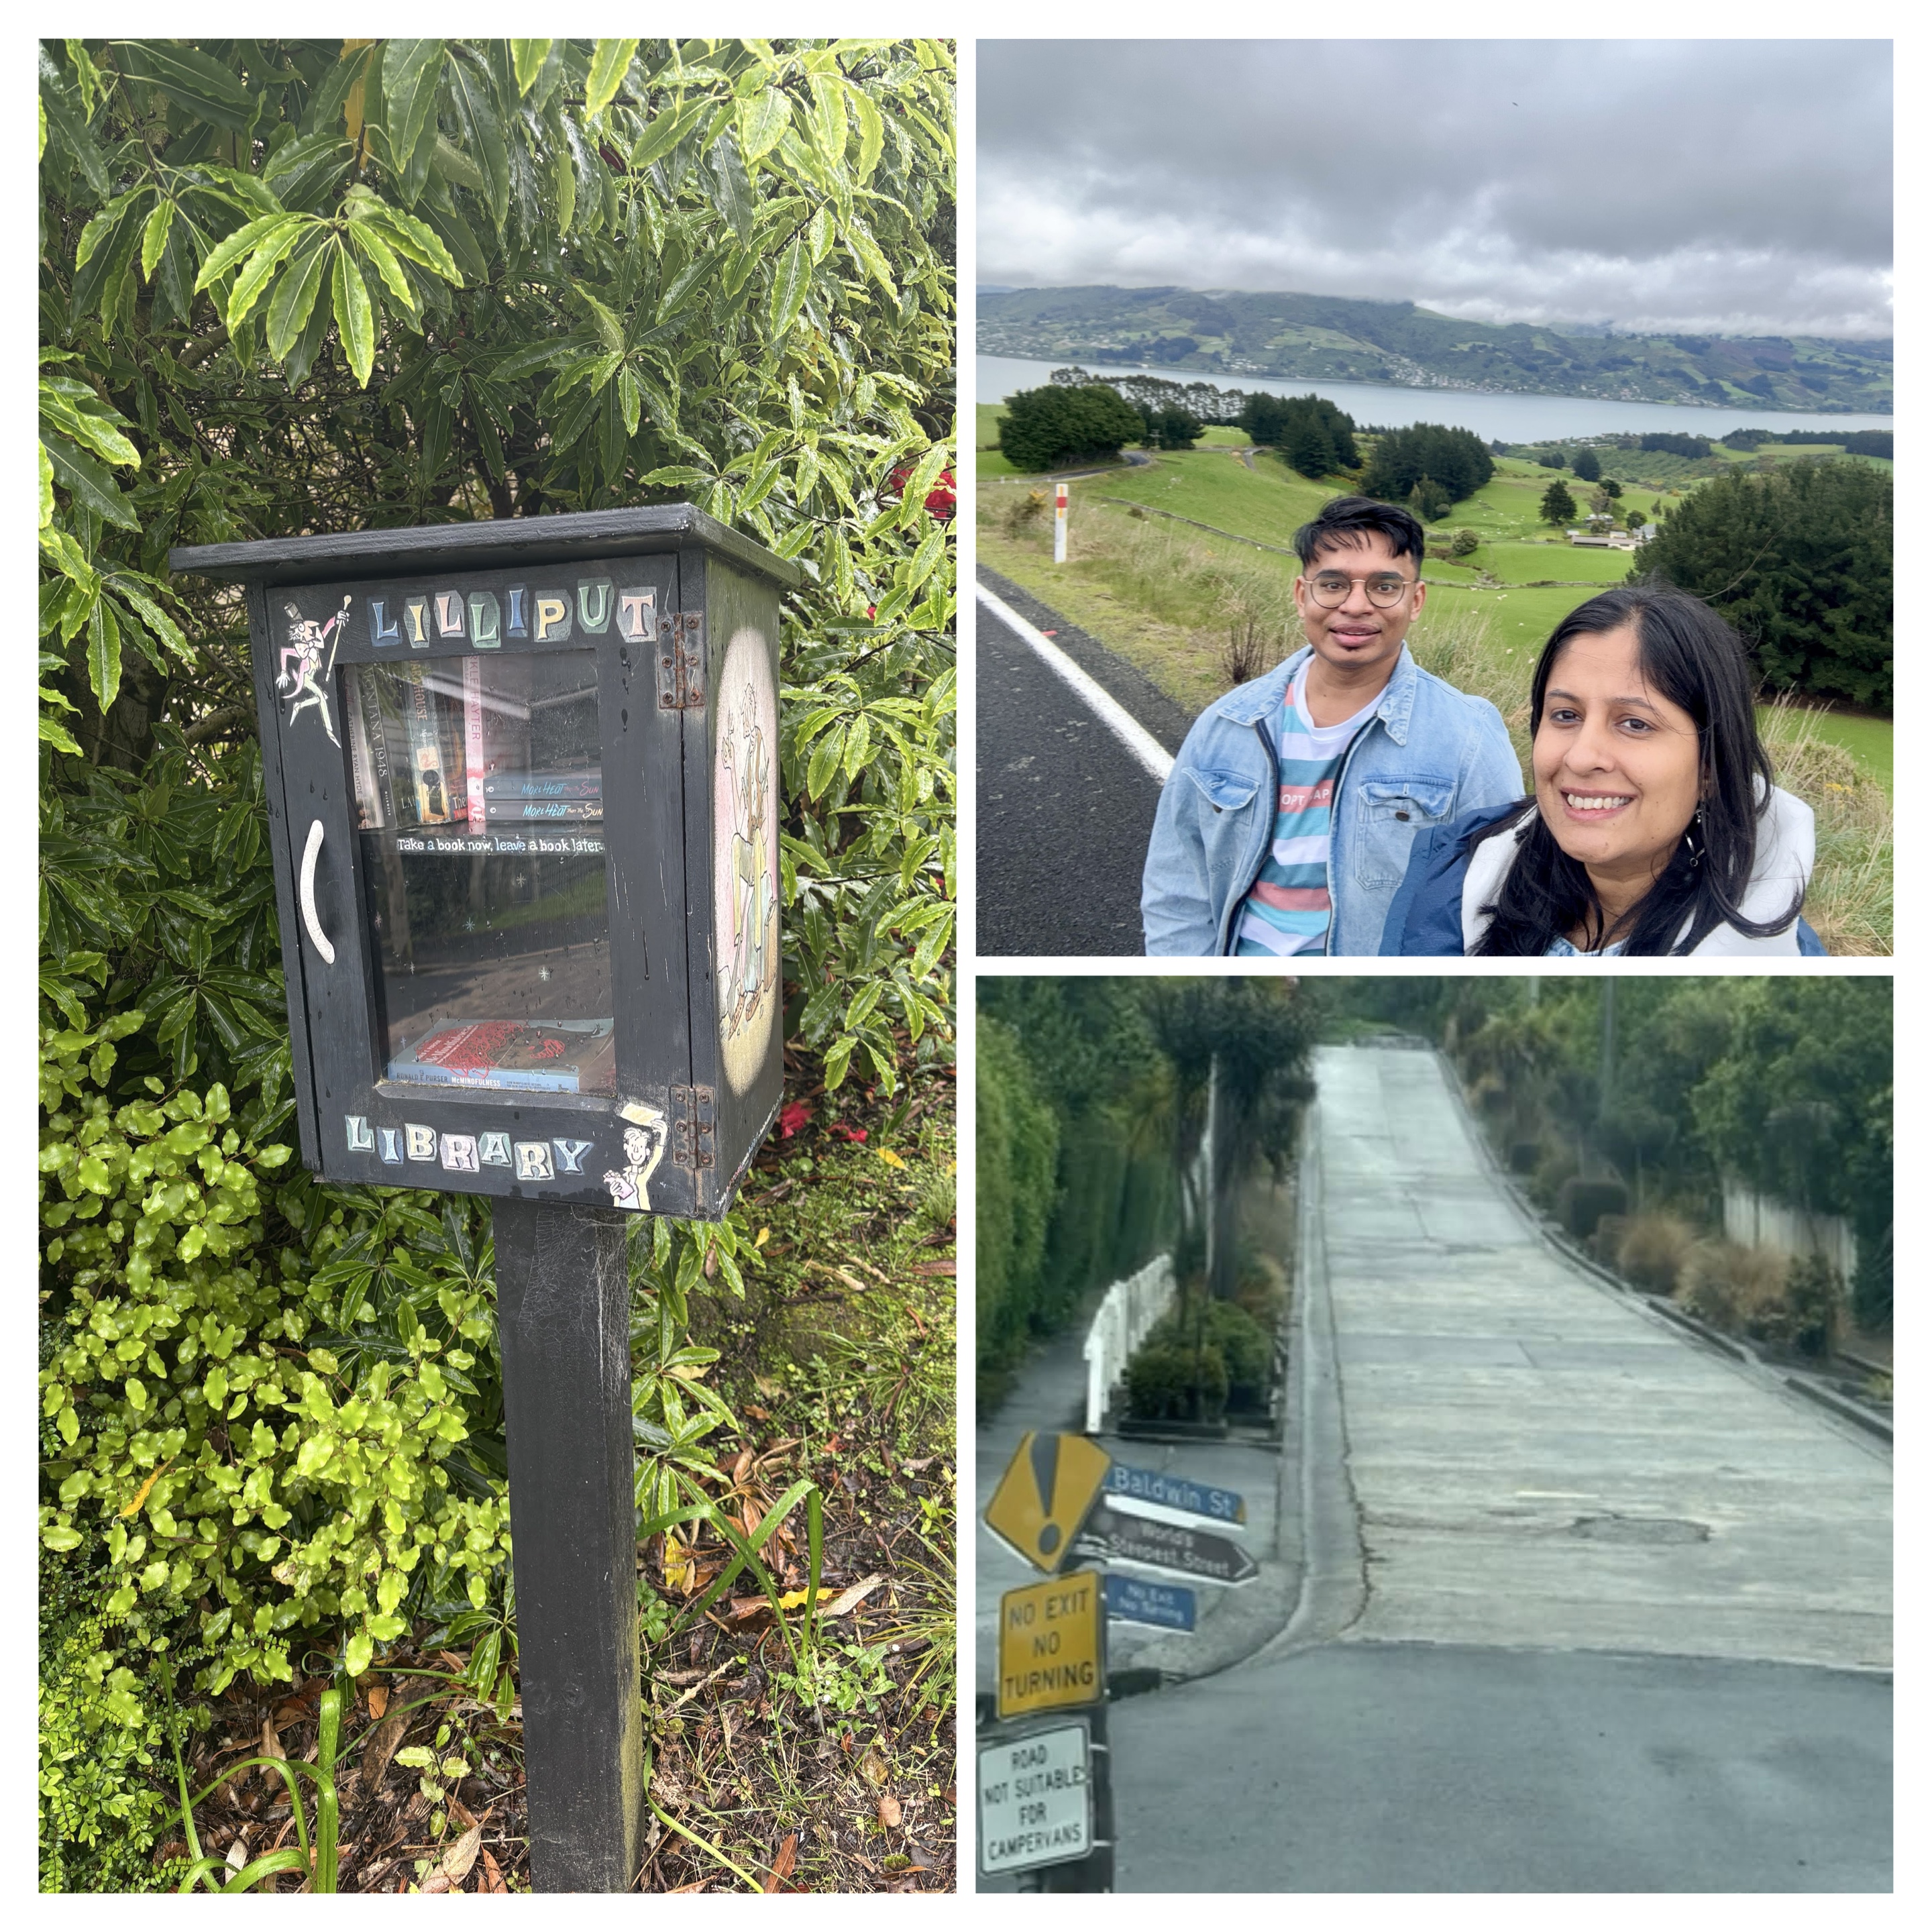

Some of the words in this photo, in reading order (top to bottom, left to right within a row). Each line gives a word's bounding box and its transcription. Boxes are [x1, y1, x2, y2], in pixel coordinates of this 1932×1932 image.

[372, 584, 655, 643] LILLIPUT
[364, 667, 381, 741] MONTANA
[375, 747, 388, 777] 1948
[414, 686, 427, 722] HOUSE
[470, 691, 481, 741] HAYTER
[347, 711, 358, 755] CATHERINE
[355, 775, 363, 795] HYDE
[580, 781, 599, 796] SUN
[582, 803, 603, 818] SUN
[398, 839, 424, 851] Take
[427, 840, 435, 850] a
[437, 839, 466, 851] book
[468, 841, 493, 852] now,
[495, 837, 526, 851] leave
[529, 840, 538, 850] a
[539, 839, 570, 851] book
[396, 1073, 419, 1081] RONALD
[426, 1075, 448, 1083] PURSER
[451, 1077, 500, 1087] McMINDFULNESS
[347, 1116, 590, 1178] LIBRARY
[1114, 1466, 1201, 1509] Baldwin
[1210, 1491, 1232, 1517] St
[1183, 1551, 1229, 1576] Street
[1009, 1603, 1035, 1631] NO
[1045, 1588, 1089, 1619] EXIT
[1033, 1631, 1060, 1658] NO
[1004, 1661, 1095, 1699] TURNING
[1012, 1744, 1047, 1772] ROAD
[985, 1782, 1008, 1805] NOT
[1015, 1766, 1082, 1800] SUITABLE
[1019, 1801, 1047, 1826] FOR
[988, 1822, 1081, 1862] CAMPERVANS
